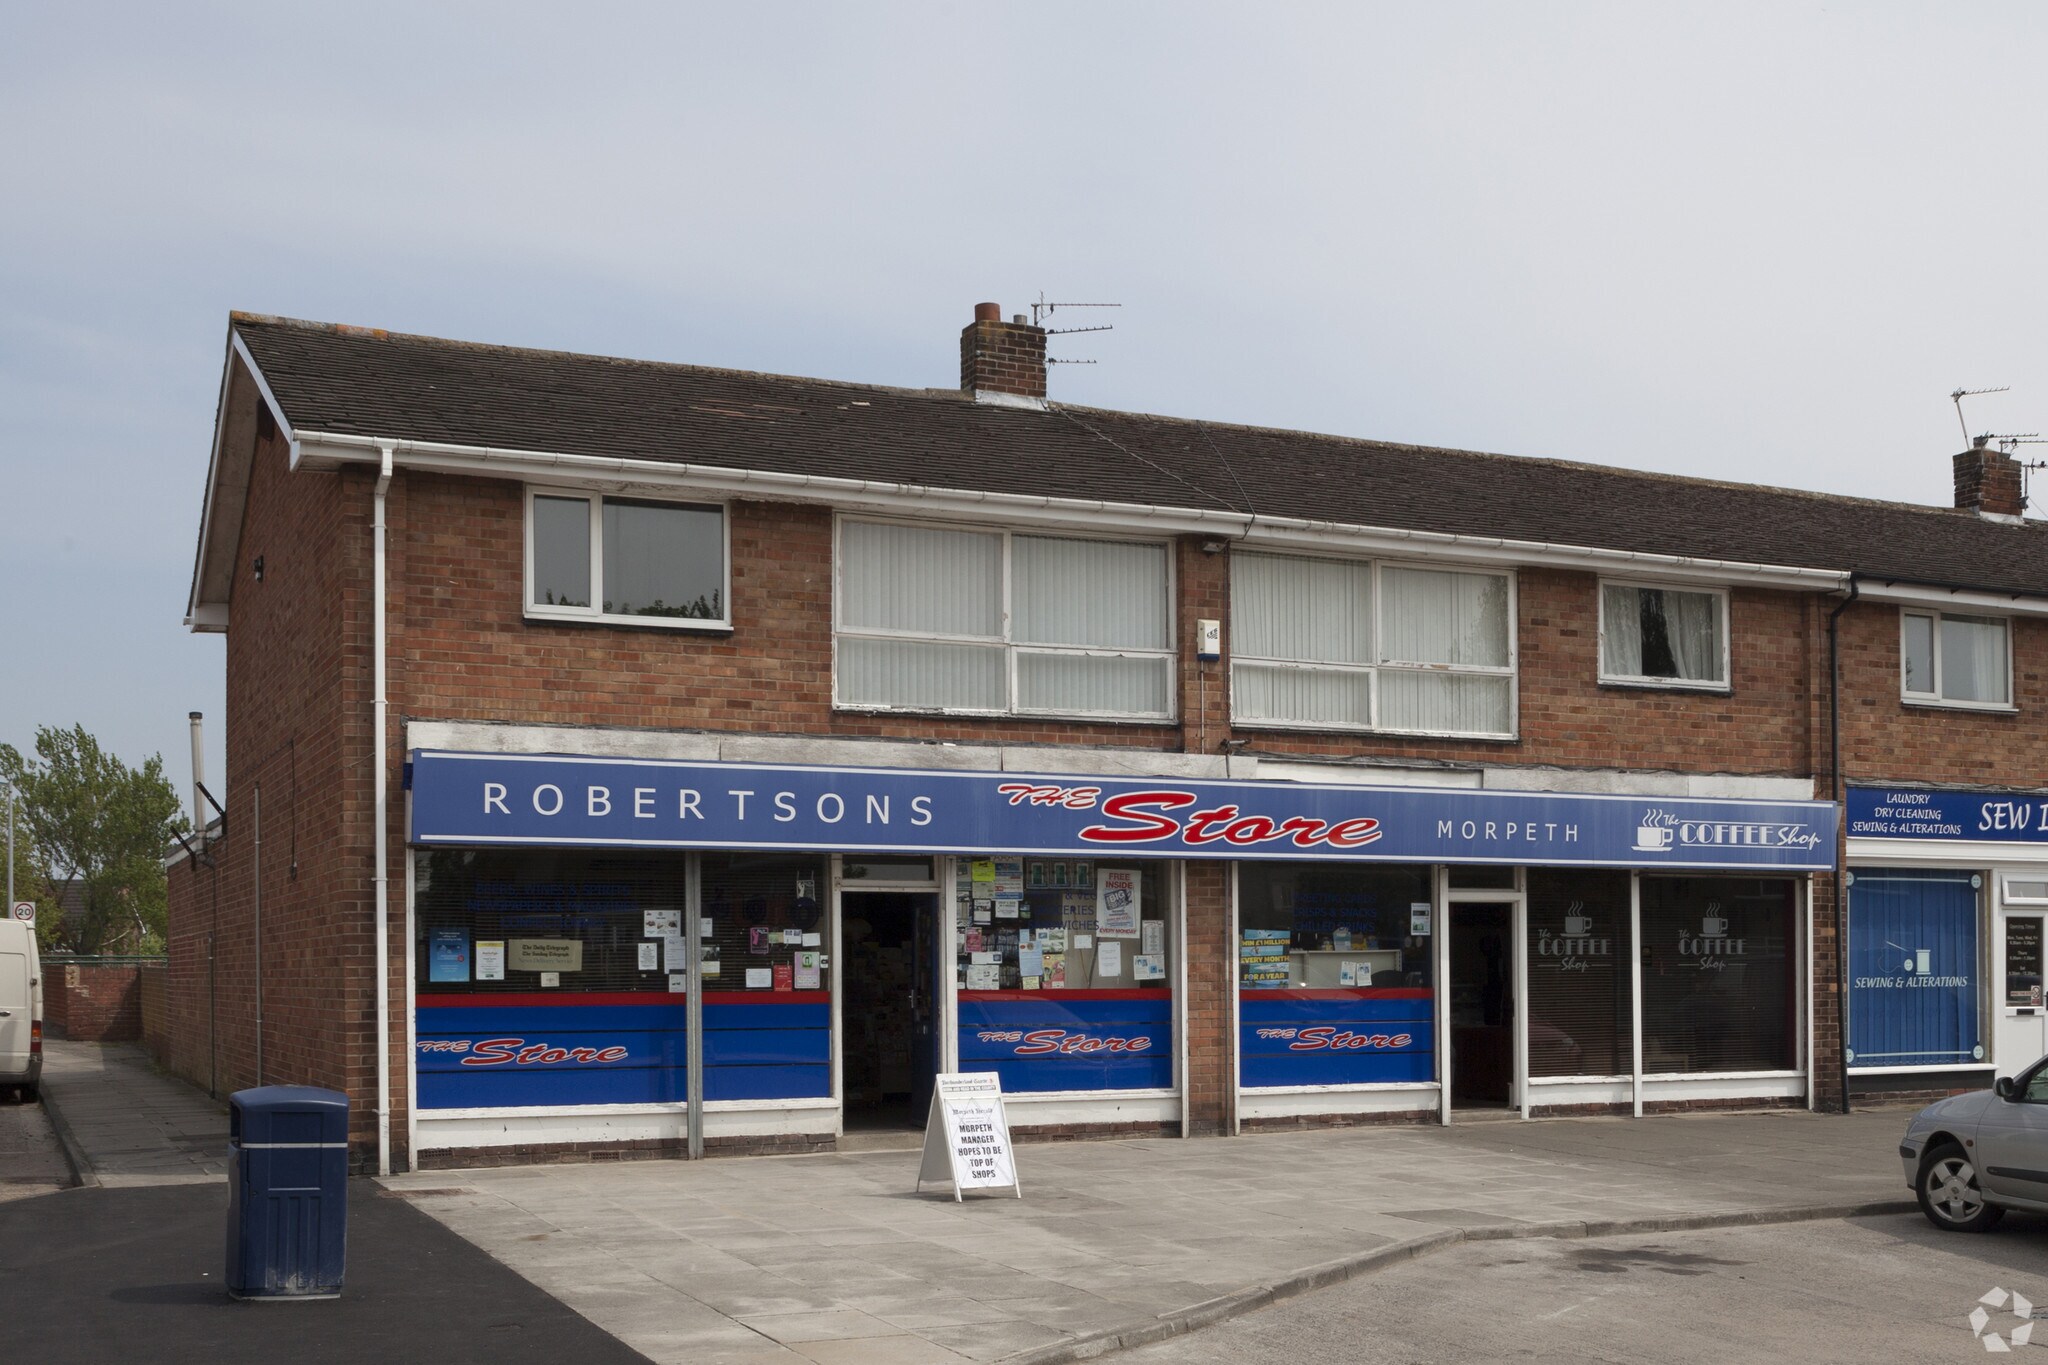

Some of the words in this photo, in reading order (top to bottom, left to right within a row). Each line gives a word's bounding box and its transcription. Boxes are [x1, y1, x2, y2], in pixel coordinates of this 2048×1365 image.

[484, 783, 933, 826] ROBERTSONS
[1886, 792, 1931, 804] LAUNDRY
[998, 783, 1102, 810] THE
[1078, 790, 1382, 848] Store
[1663, 814, 1681, 826] The
[1874, 807, 1894, 818] DRY
[1895, 808, 1942, 820] CLEANING
[1978, 801, 2031, 831] SEW
[1437, 820, 1579, 842] MORPETH
[1852, 821, 1888, 833] SEWING
[1889, 822, 1898, 834] &
[1899, 822, 1962, 835] ALTERATIONS
[1680, 823, 1774, 845] COFFEE
[1777, 826, 1822, 850] Shop
[1108, 872, 1131, 881] FREE
[1105, 881, 1133, 889] INSIDE
[1110, 890, 1126, 903] BIG
[18, 908, 31, 916] 20
[1538, 928, 1551, 938] The
[1678, 928, 1691, 938] The
[1264, 938, 1291, 946] MILLION
[1538, 938, 1612, 955] COFFEE
[1678, 938, 1748, 955] COFFEE
[1560, 956, 1589, 972] Shop
[1700, 956, 1727, 972] Shop
[1266, 972, 1285, 980] YEAR
[1855, 976, 1894, 988] SEWING
[1895, 976, 1904, 988] &
[1906, 975, 1968, 988] ALTERATIONS
[977, 1030, 1022, 1043] THE
[1014, 1029, 1152, 1055] Store
[1257, 1028, 1295, 1040] THE
[1288, 1027, 1413, 1051] Store
[417, 1040, 472, 1053] THE
[460, 1038, 629, 1066] Store
[959, 1123, 993, 1133] MORPETH
[961, 1135, 995, 1144] MANAGER
[958, 1147, 981, 1156] HOPES
[982, 1146, 992, 1155] TO
[993, 1145, 1002, 1155] BE
[970, 1158, 984, 1167] TOP
[985, 1158, 994, 1167] OF
[971, 1169, 996, 1179] SHOPS
